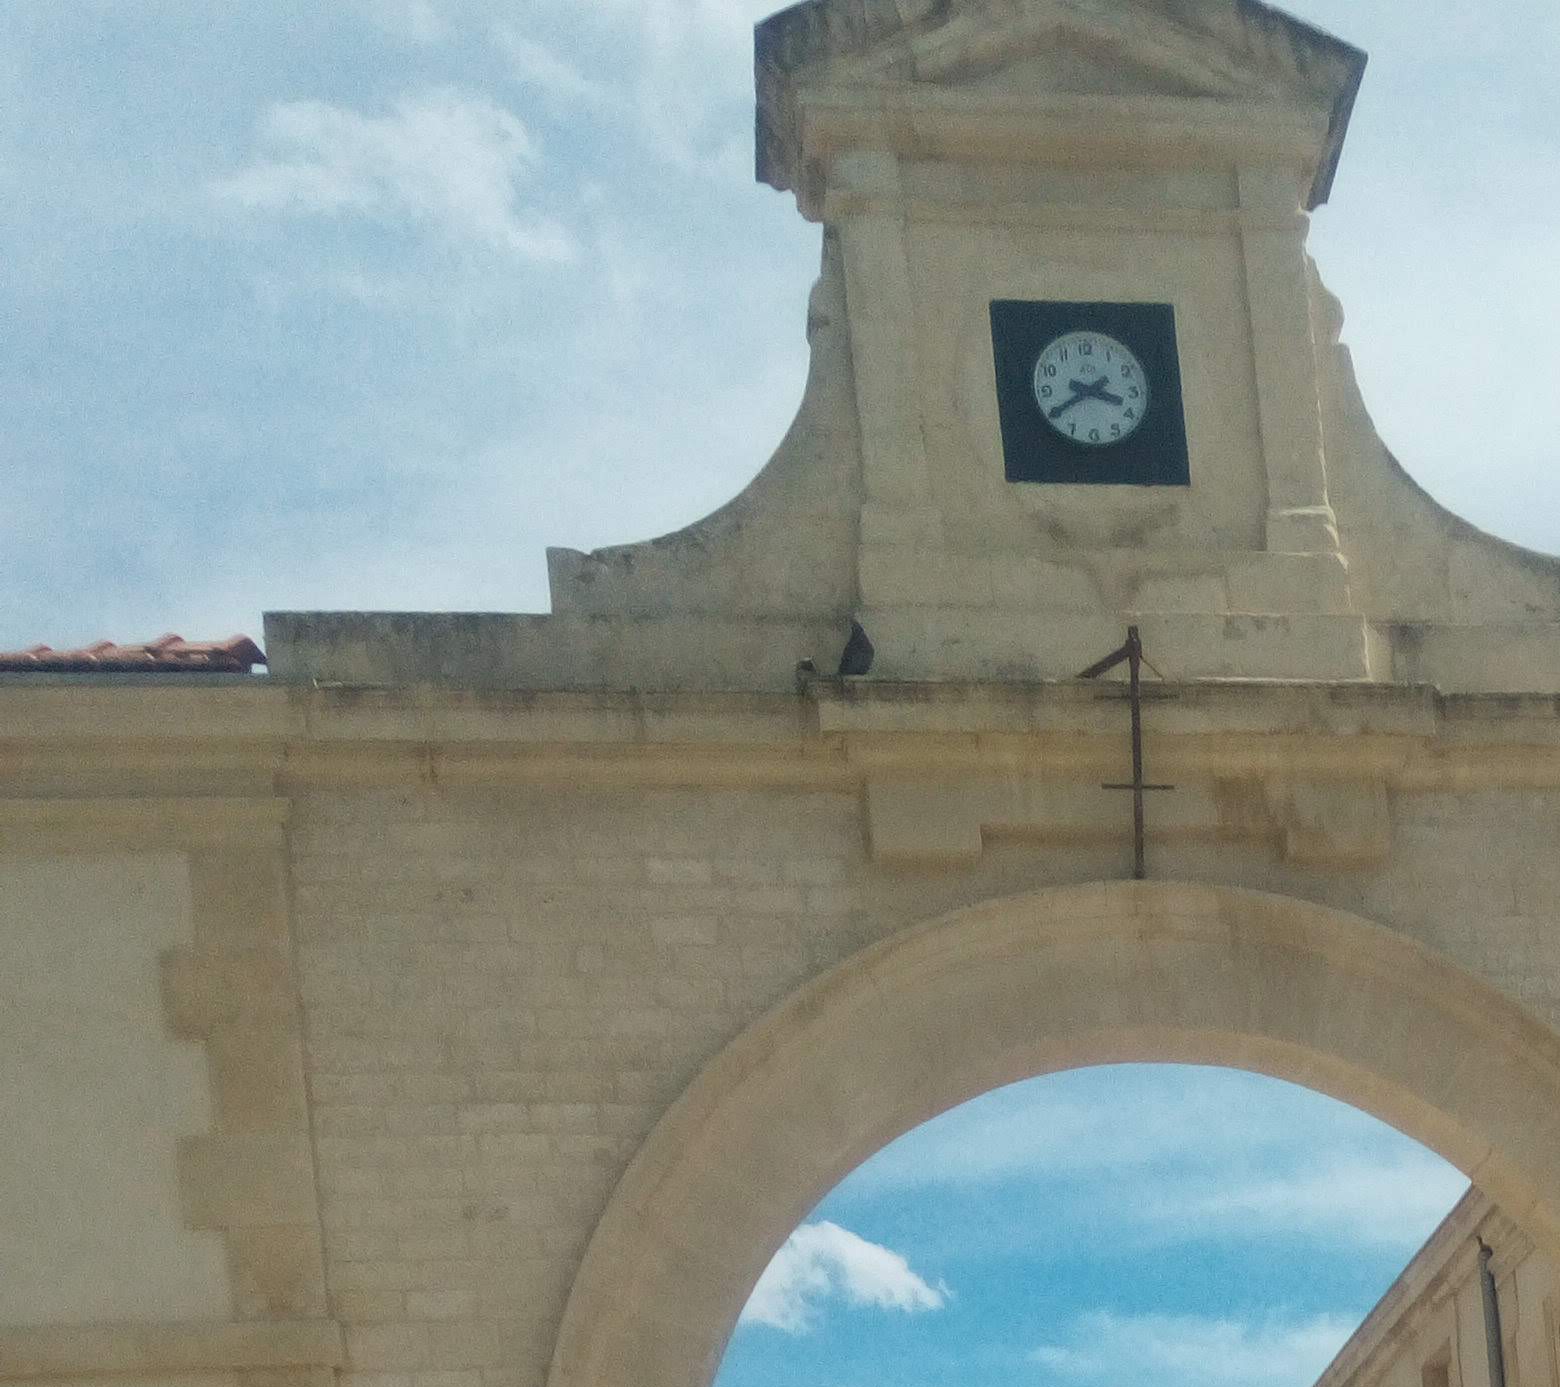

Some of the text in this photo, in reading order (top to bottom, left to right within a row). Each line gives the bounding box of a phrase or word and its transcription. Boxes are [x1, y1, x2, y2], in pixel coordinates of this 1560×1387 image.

[1059, 348, 1069, 362] 11
[1079, 341, 1093, 356] 12
[1043, 364, 1057, 377] 10
[1040, 385, 1052, 398] 9
[1128, 386, 1139, 399] 3
[1123, 407, 1136, 420] 4
[1068, 423, 1077, 436] 7
[1088, 428, 1100, 441] 6
